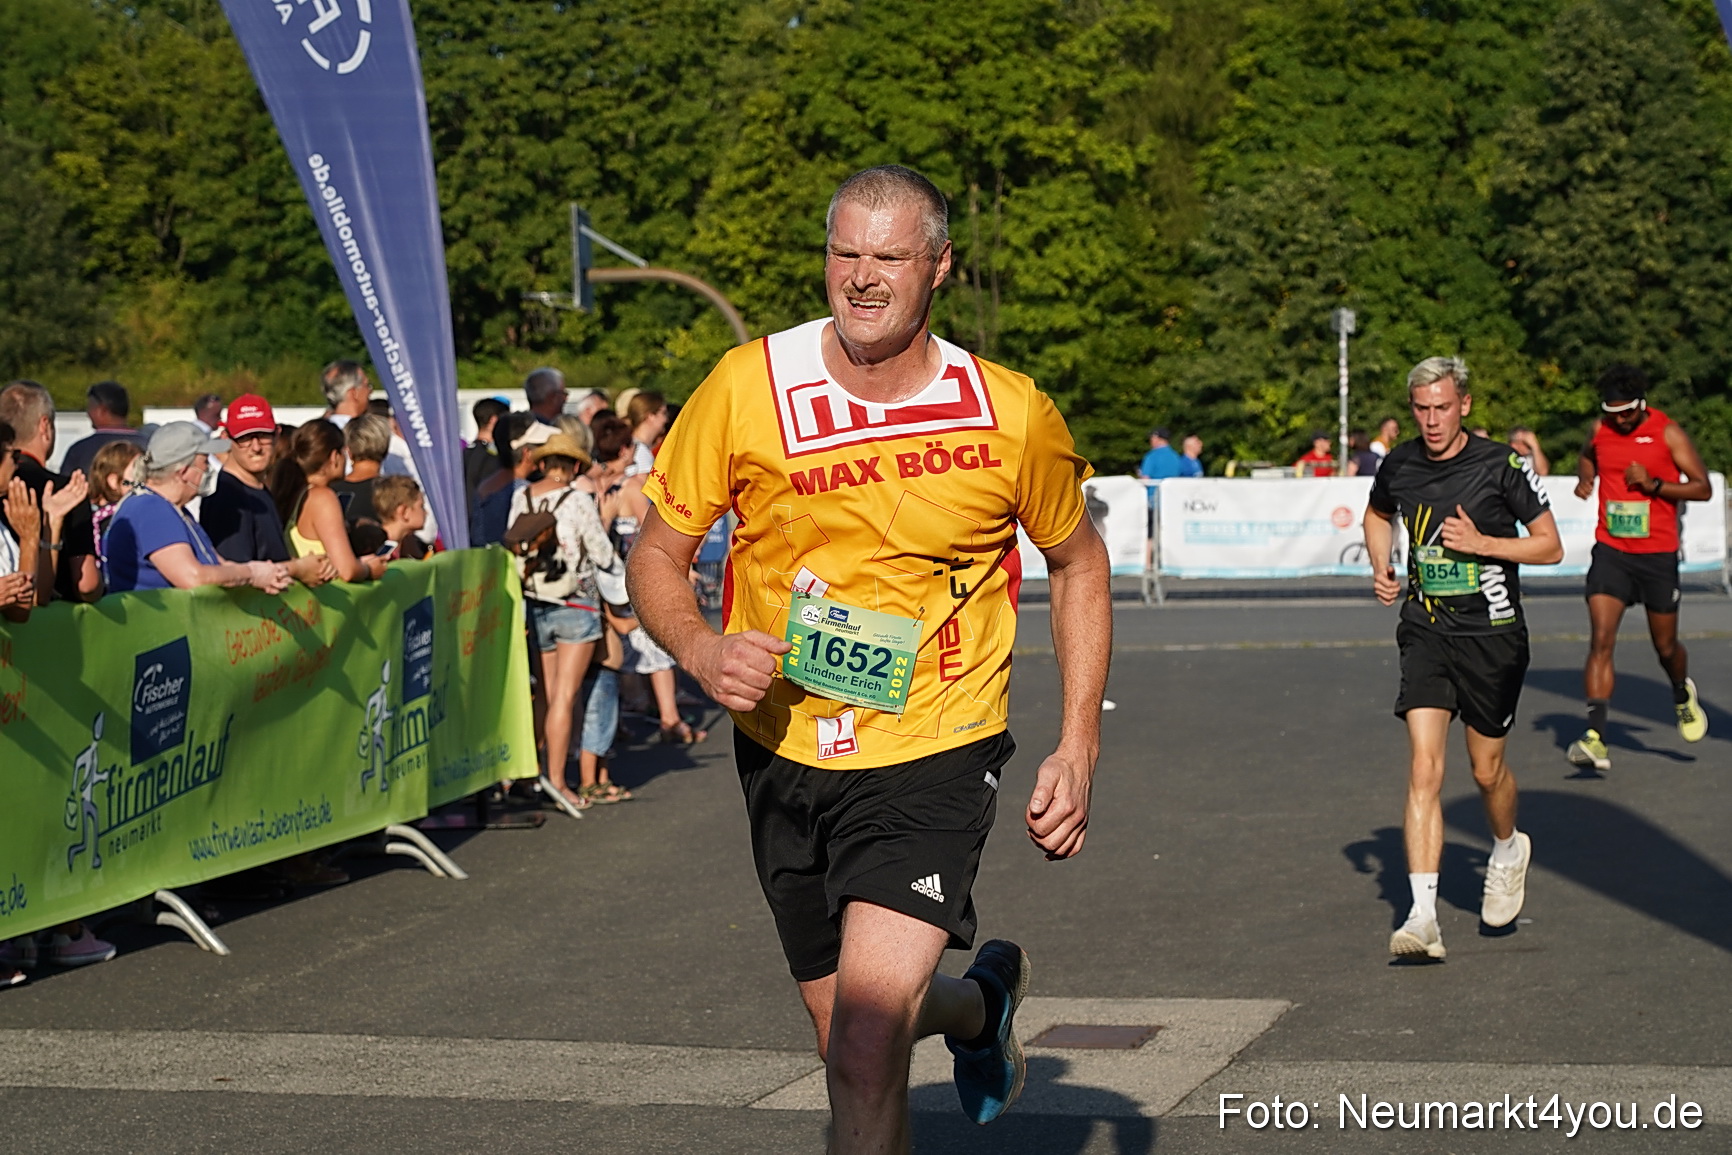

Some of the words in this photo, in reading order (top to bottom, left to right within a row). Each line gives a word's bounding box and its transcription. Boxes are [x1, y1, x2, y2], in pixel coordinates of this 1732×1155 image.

[789, 456, 885, 496] MAX
[895, 440, 1002, 479] BÖGL
[1426, 563, 1460, 579] 854
[820, 617, 861, 632] Firmenlauf
[788, 634, 803, 667] RUN
[806, 630, 893, 679] 1652
[141, 676, 185, 707] Fischer
[803, 662, 848, 684] Lindner
[850, 676, 882, 692] Erich
[888, 656, 908, 699] 2022
[105, 712, 235, 832] firmenlauf
[107, 813, 163, 859] neumarkt
[911, 881, 945, 903] adidas
